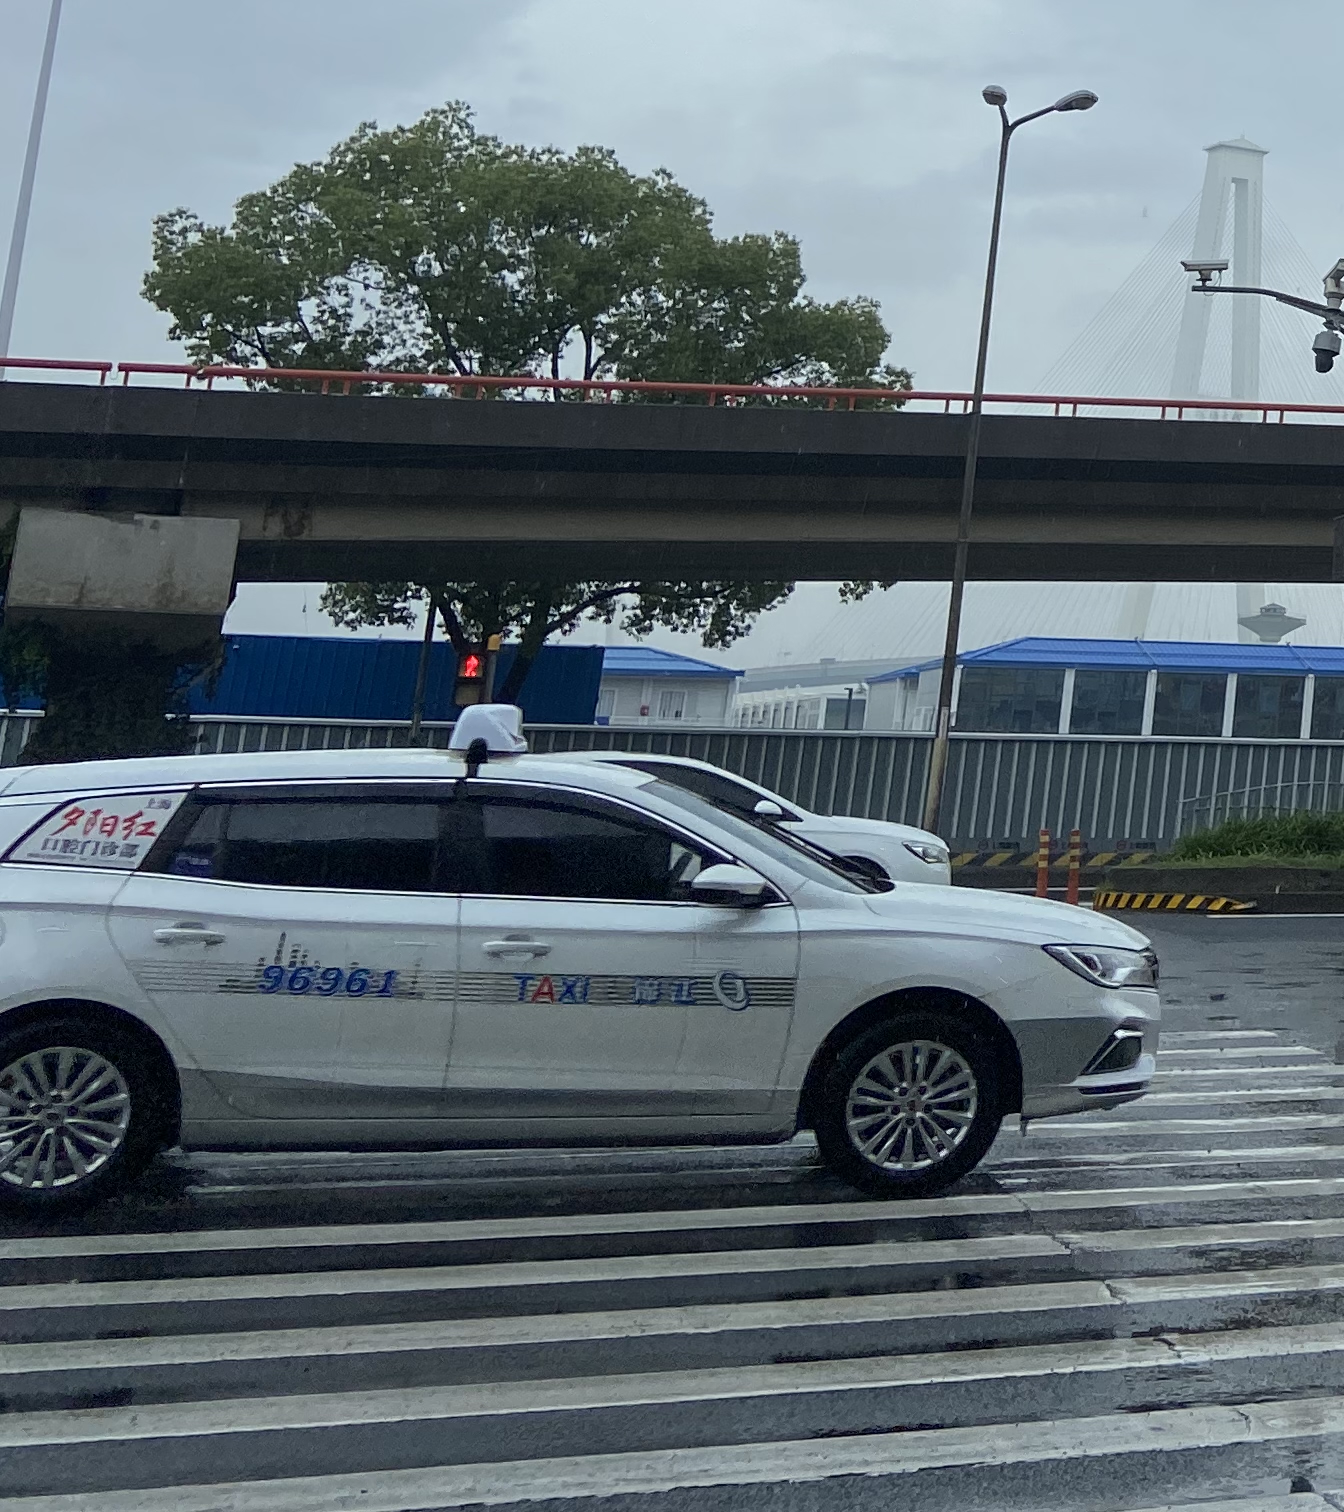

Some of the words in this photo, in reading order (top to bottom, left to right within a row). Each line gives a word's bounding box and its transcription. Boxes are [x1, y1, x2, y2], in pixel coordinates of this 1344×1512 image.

[50, 806, 157, 841] 夕阳红
[260, 964, 398, 999] 96961
[513, 974, 590, 1004] TAXI
